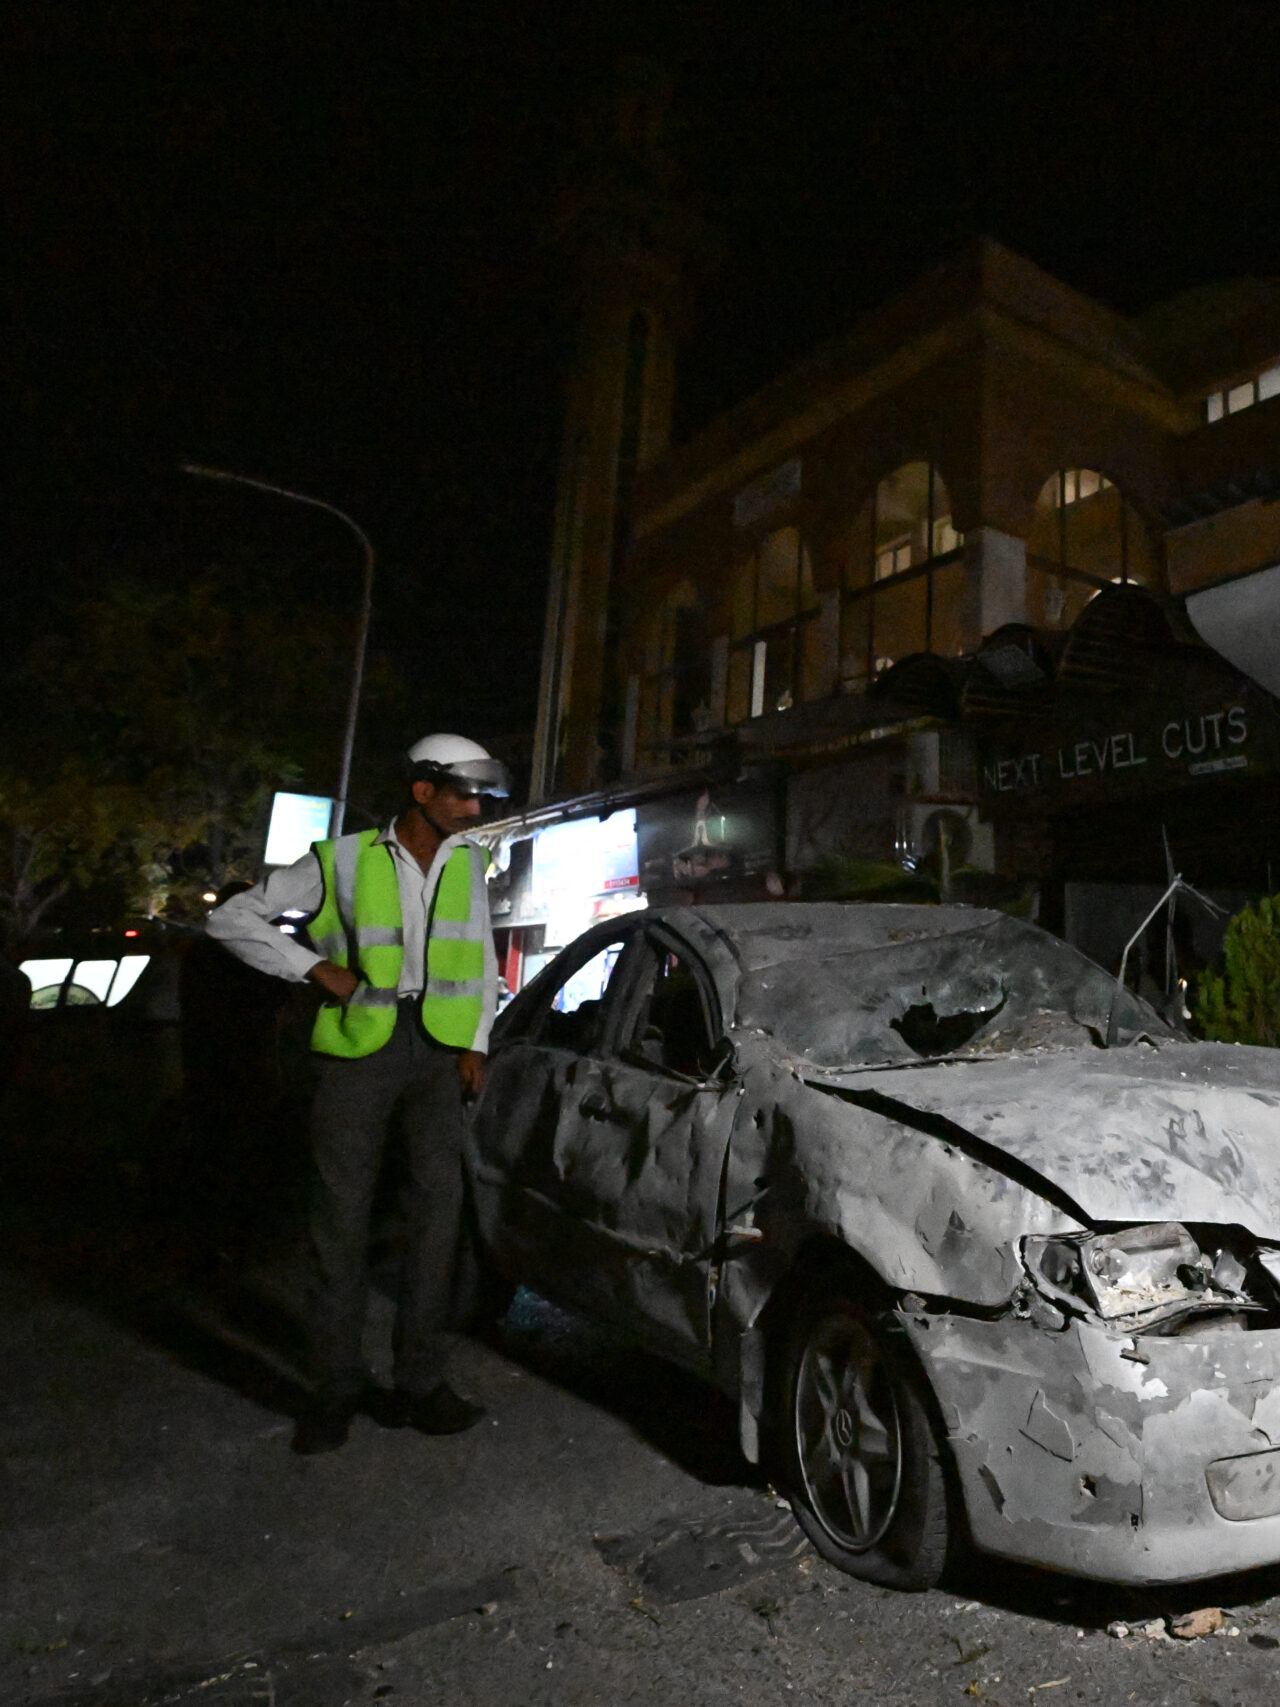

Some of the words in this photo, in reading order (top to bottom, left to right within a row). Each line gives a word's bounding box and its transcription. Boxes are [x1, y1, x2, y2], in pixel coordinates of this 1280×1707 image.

[984, 755, 1041, 792] NEXT
[1058, 732, 1148, 779] LEVEL
[1162, 706, 1247, 758] CUTS
